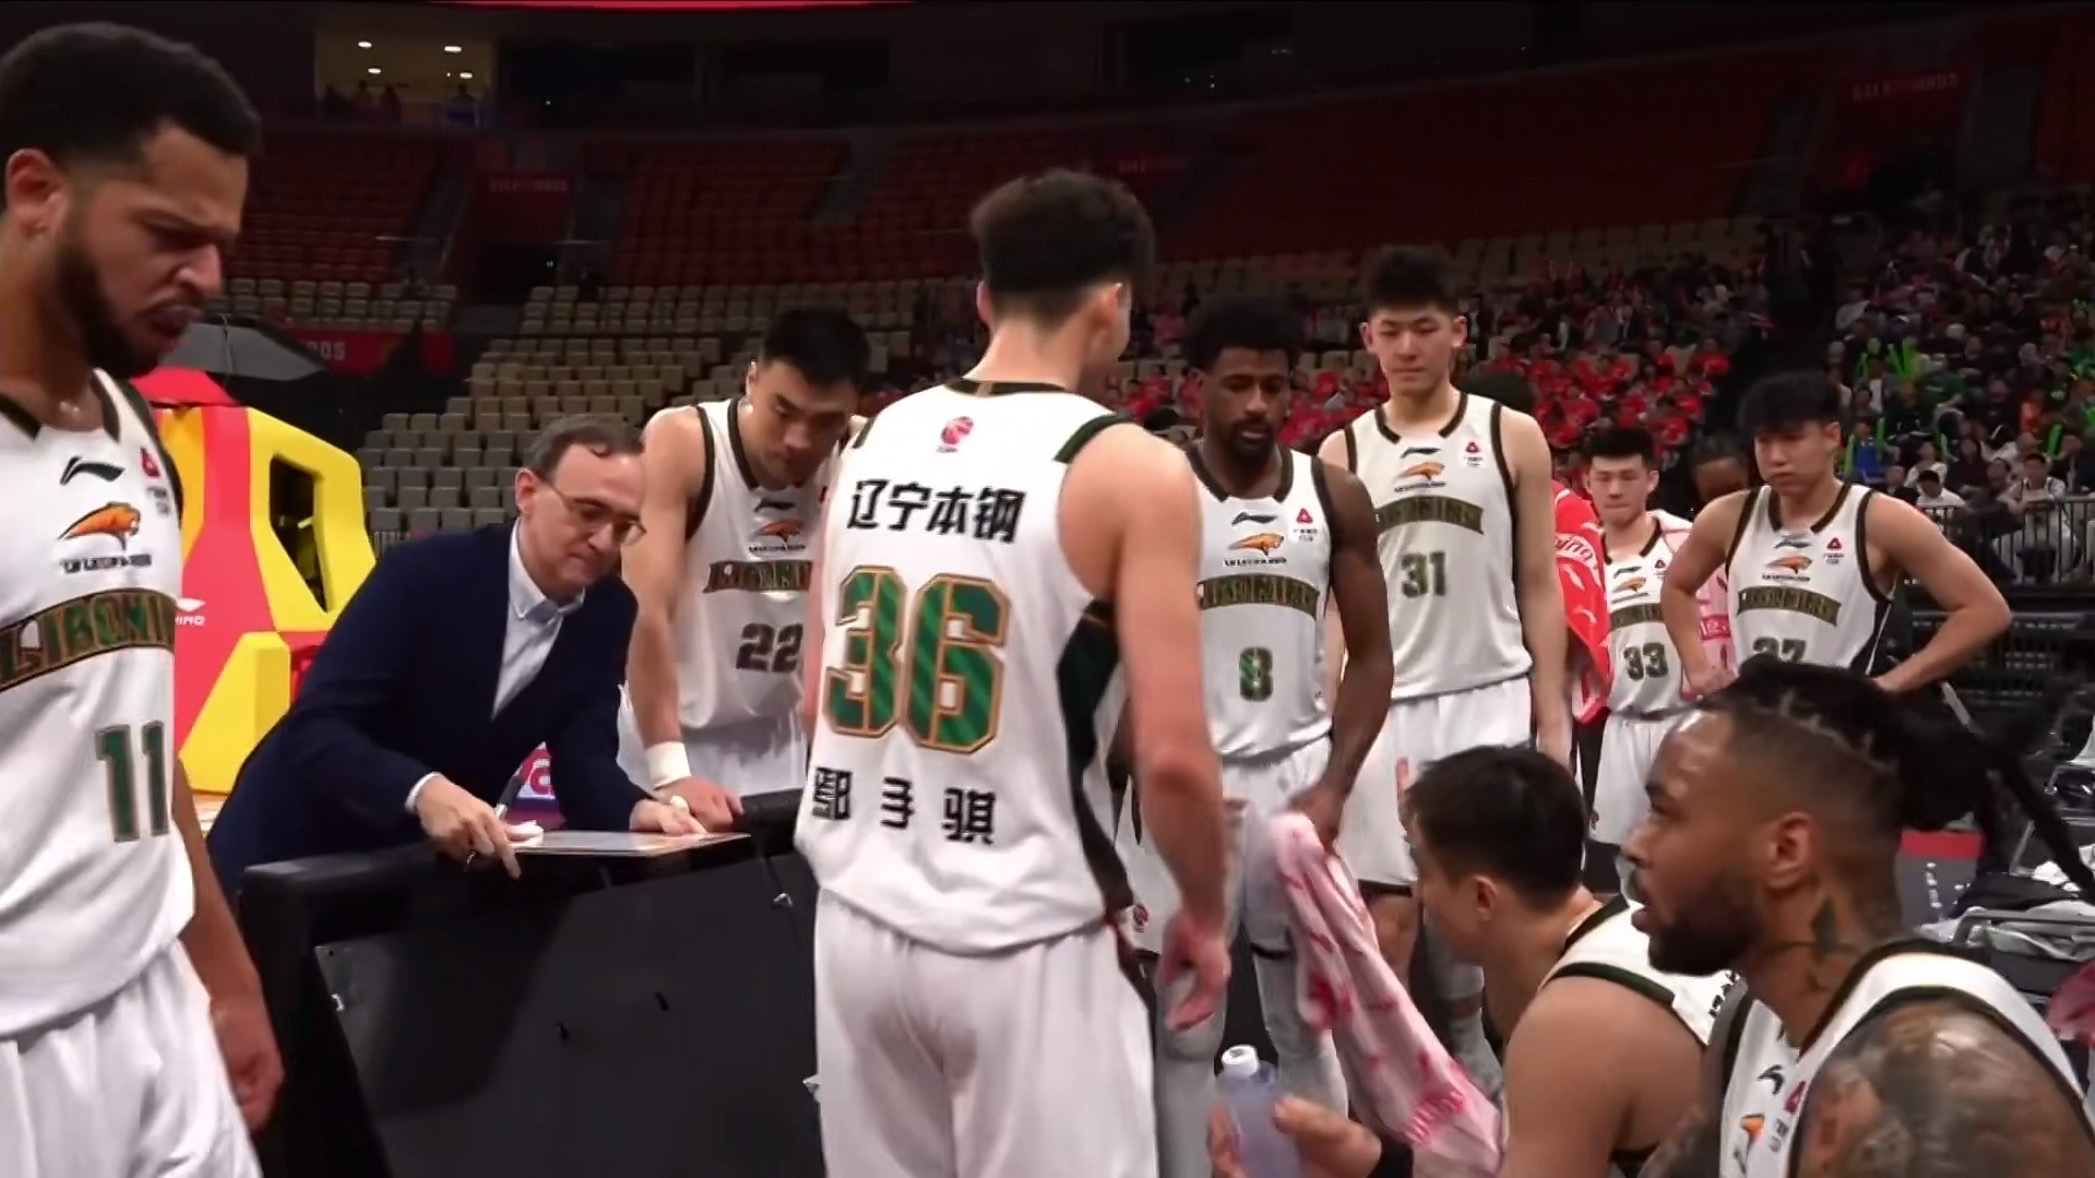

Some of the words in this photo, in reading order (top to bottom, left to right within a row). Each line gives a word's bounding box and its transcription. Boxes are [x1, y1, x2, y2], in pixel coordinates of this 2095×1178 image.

[847, 479, 1027, 543] 辽宁本钢
[1402, 552, 1446, 597] 31
[735, 622, 804, 673] 22
[822, 564, 1012, 754] 36
[1238, 647, 1273, 702] 8
[1623, 642, 1669, 681] 33
[94, 721, 170, 842] 11
